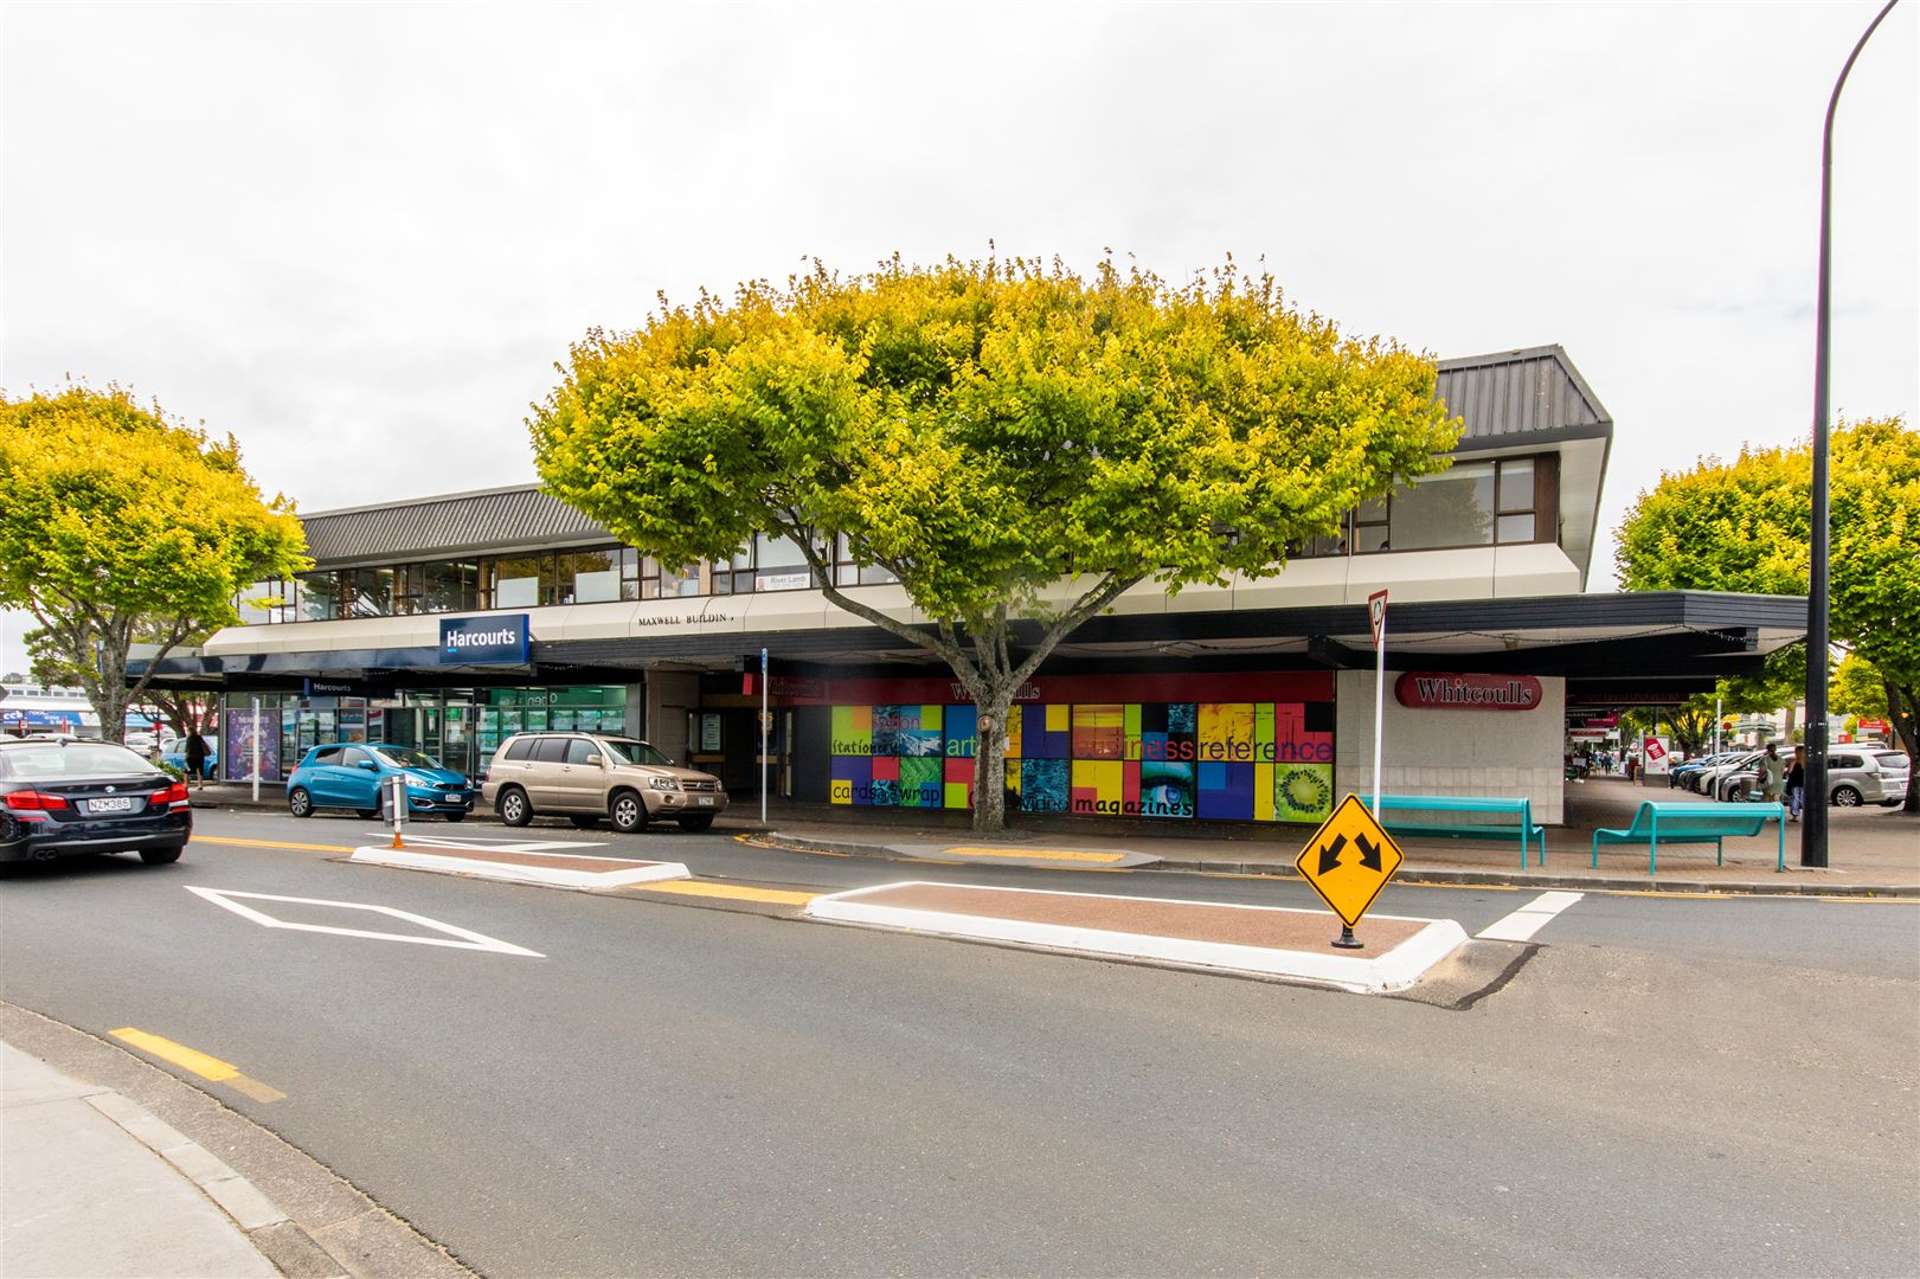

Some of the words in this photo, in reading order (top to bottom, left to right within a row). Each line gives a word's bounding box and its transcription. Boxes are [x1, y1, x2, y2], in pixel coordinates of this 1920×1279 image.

[638, 615, 681, 626] MAXWELL
[686, 612, 735, 624] BUILDIN
[447, 628, 516, 647] Harcourts
[313, 682, 352, 692] Harcourts
[1415, 677, 1533, 704] Whitcoulls
[1199, 736, 1334, 760] reference
[832, 782, 877, 799] cards
[900, 786, 940, 806] wrap
[1075, 797, 1194, 816] magazines
